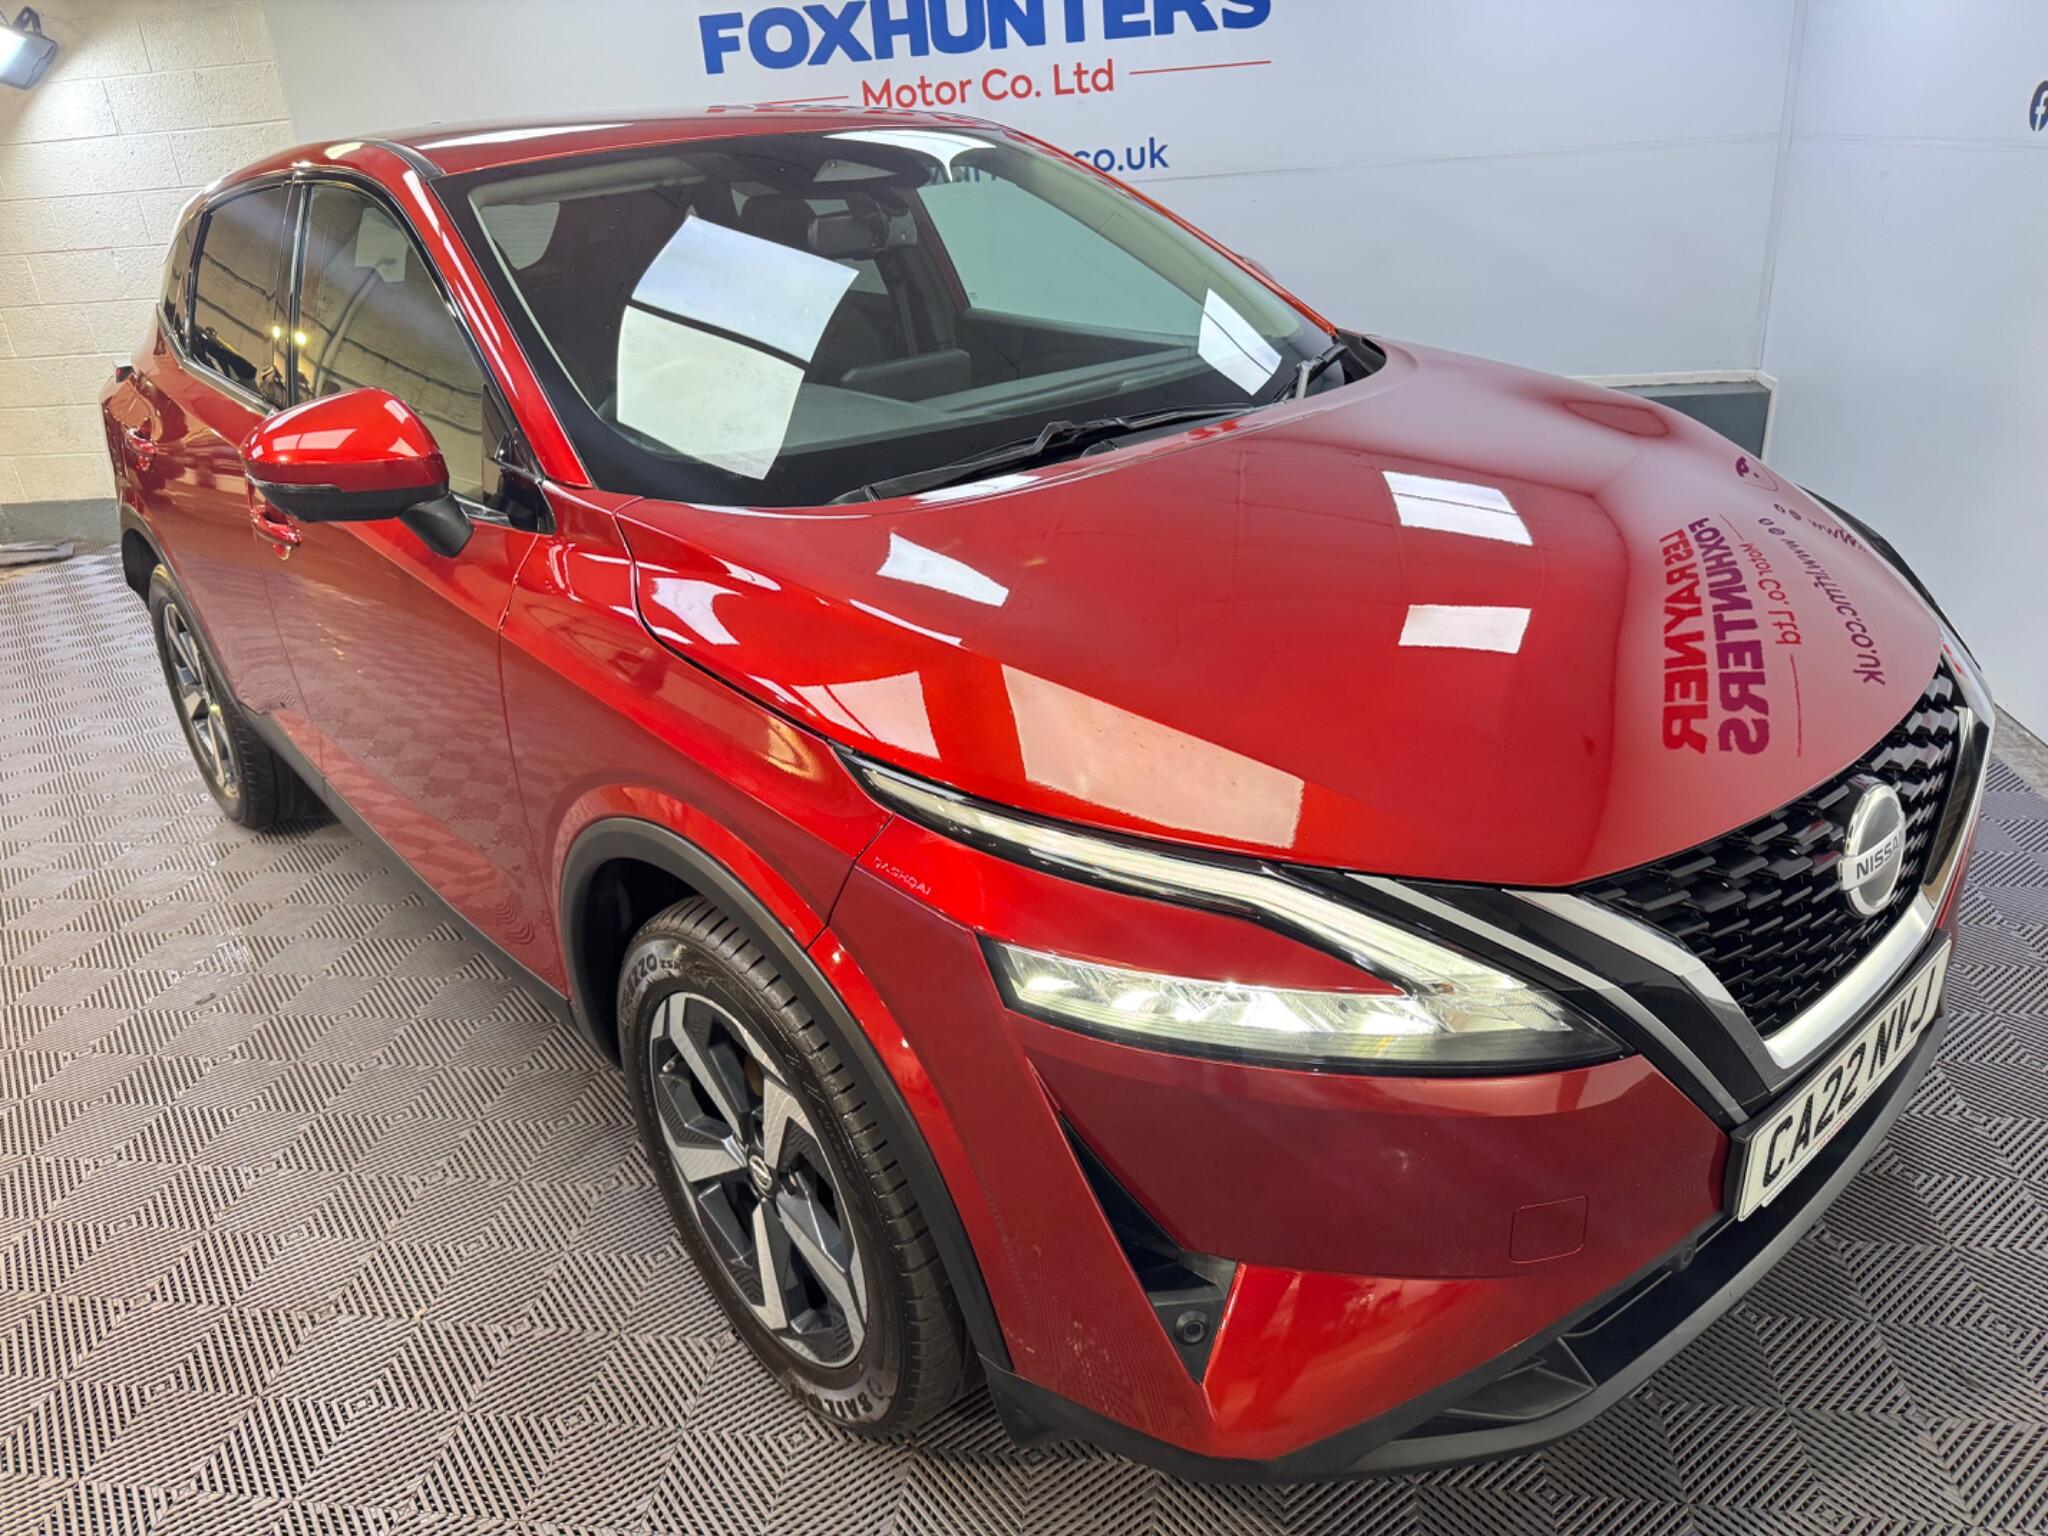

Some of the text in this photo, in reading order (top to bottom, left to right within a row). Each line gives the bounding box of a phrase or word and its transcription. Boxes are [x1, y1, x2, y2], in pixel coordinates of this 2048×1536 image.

[698, 0, 1272, 75] FOXHUNTERS
[861, 58, 1115, 109] Motor Co. Ltd
[1762, 1041, 1867, 1188] CA22
[1868, 966, 1936, 1081] NVJ
